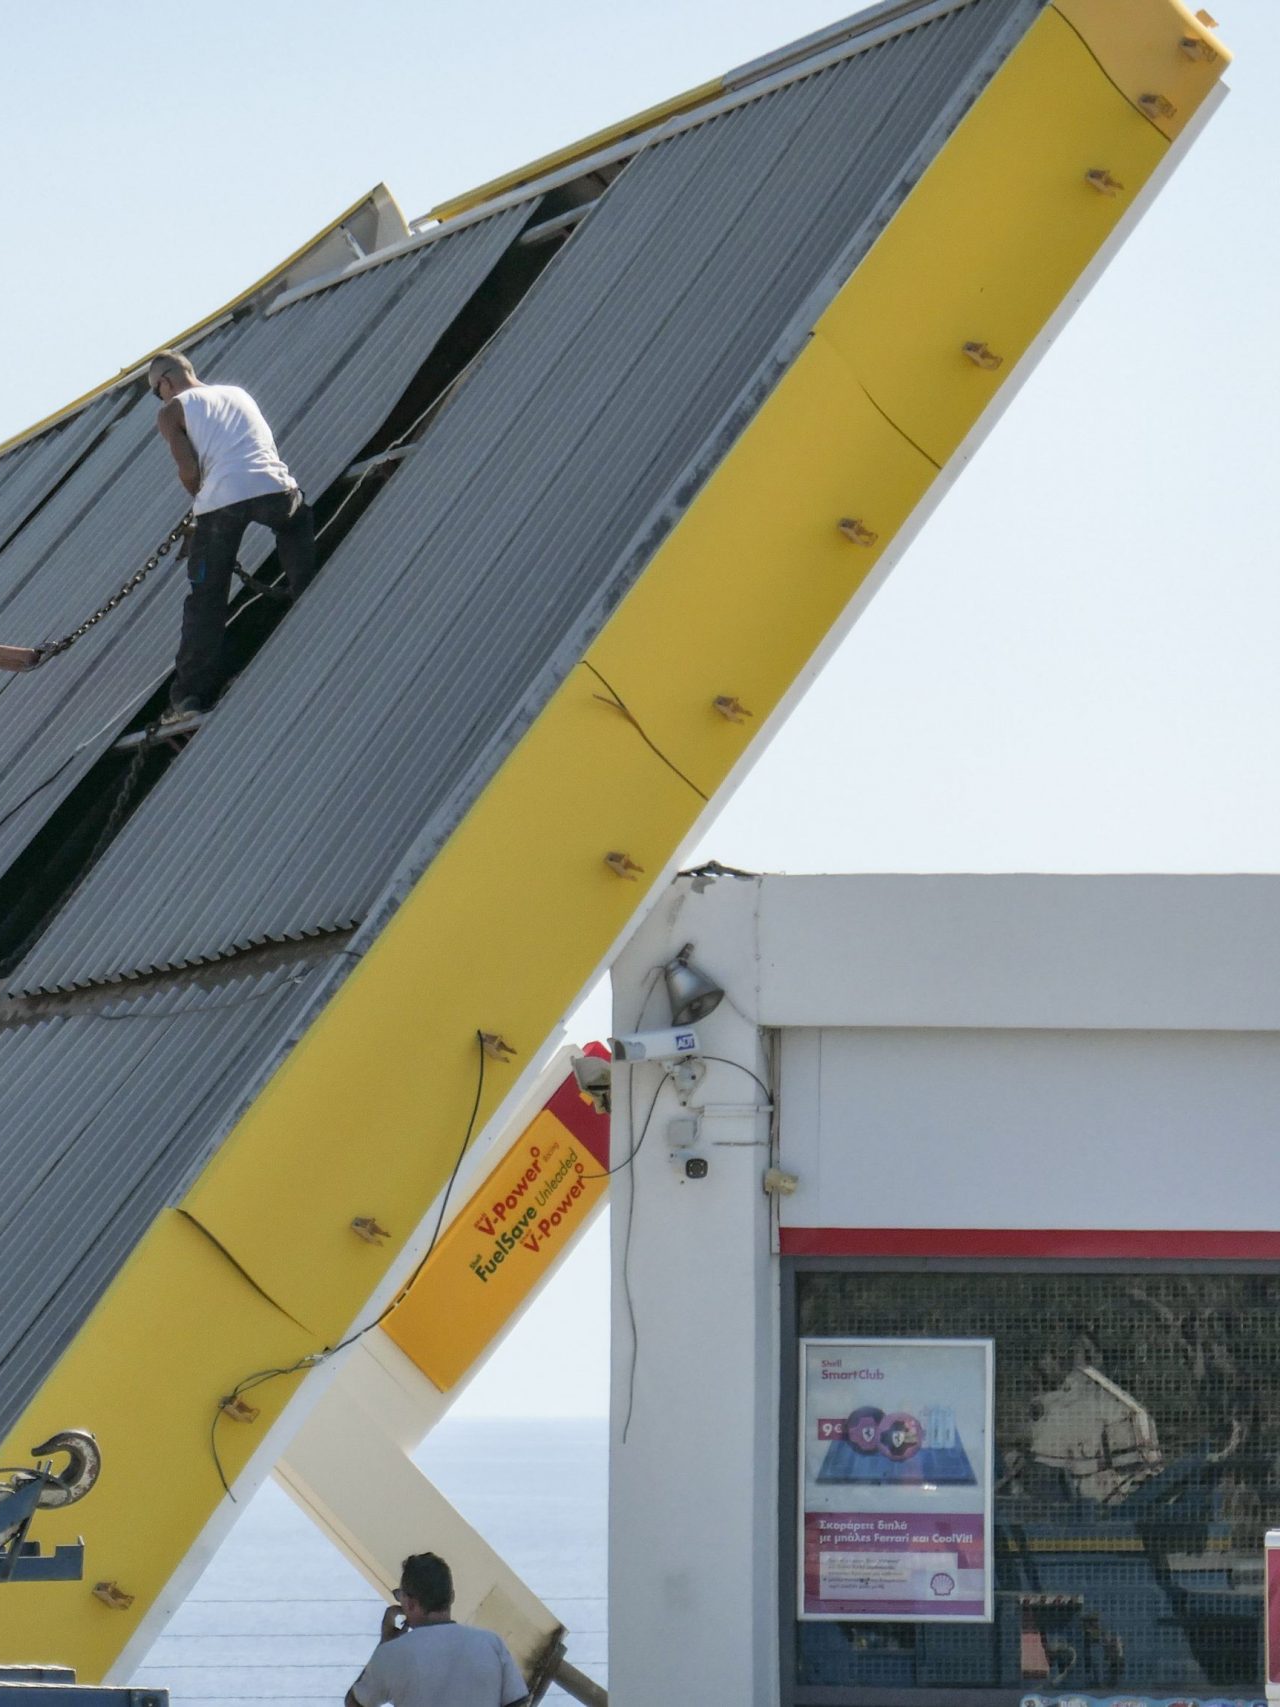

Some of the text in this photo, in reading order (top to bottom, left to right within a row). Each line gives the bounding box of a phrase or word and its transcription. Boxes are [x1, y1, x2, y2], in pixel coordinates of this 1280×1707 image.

[475, 1147, 578, 1283] FuelSave Unleaded
[477, 1159, 541, 1236] V-Power
[523, 1176, 585, 1253] V-Power
[821, 1359, 842, 1368] Shell
[819, 1535, 832, 1544] με
[874, 1533, 909, 1543] Ferrari
[912, 1535, 929, 1543] και
